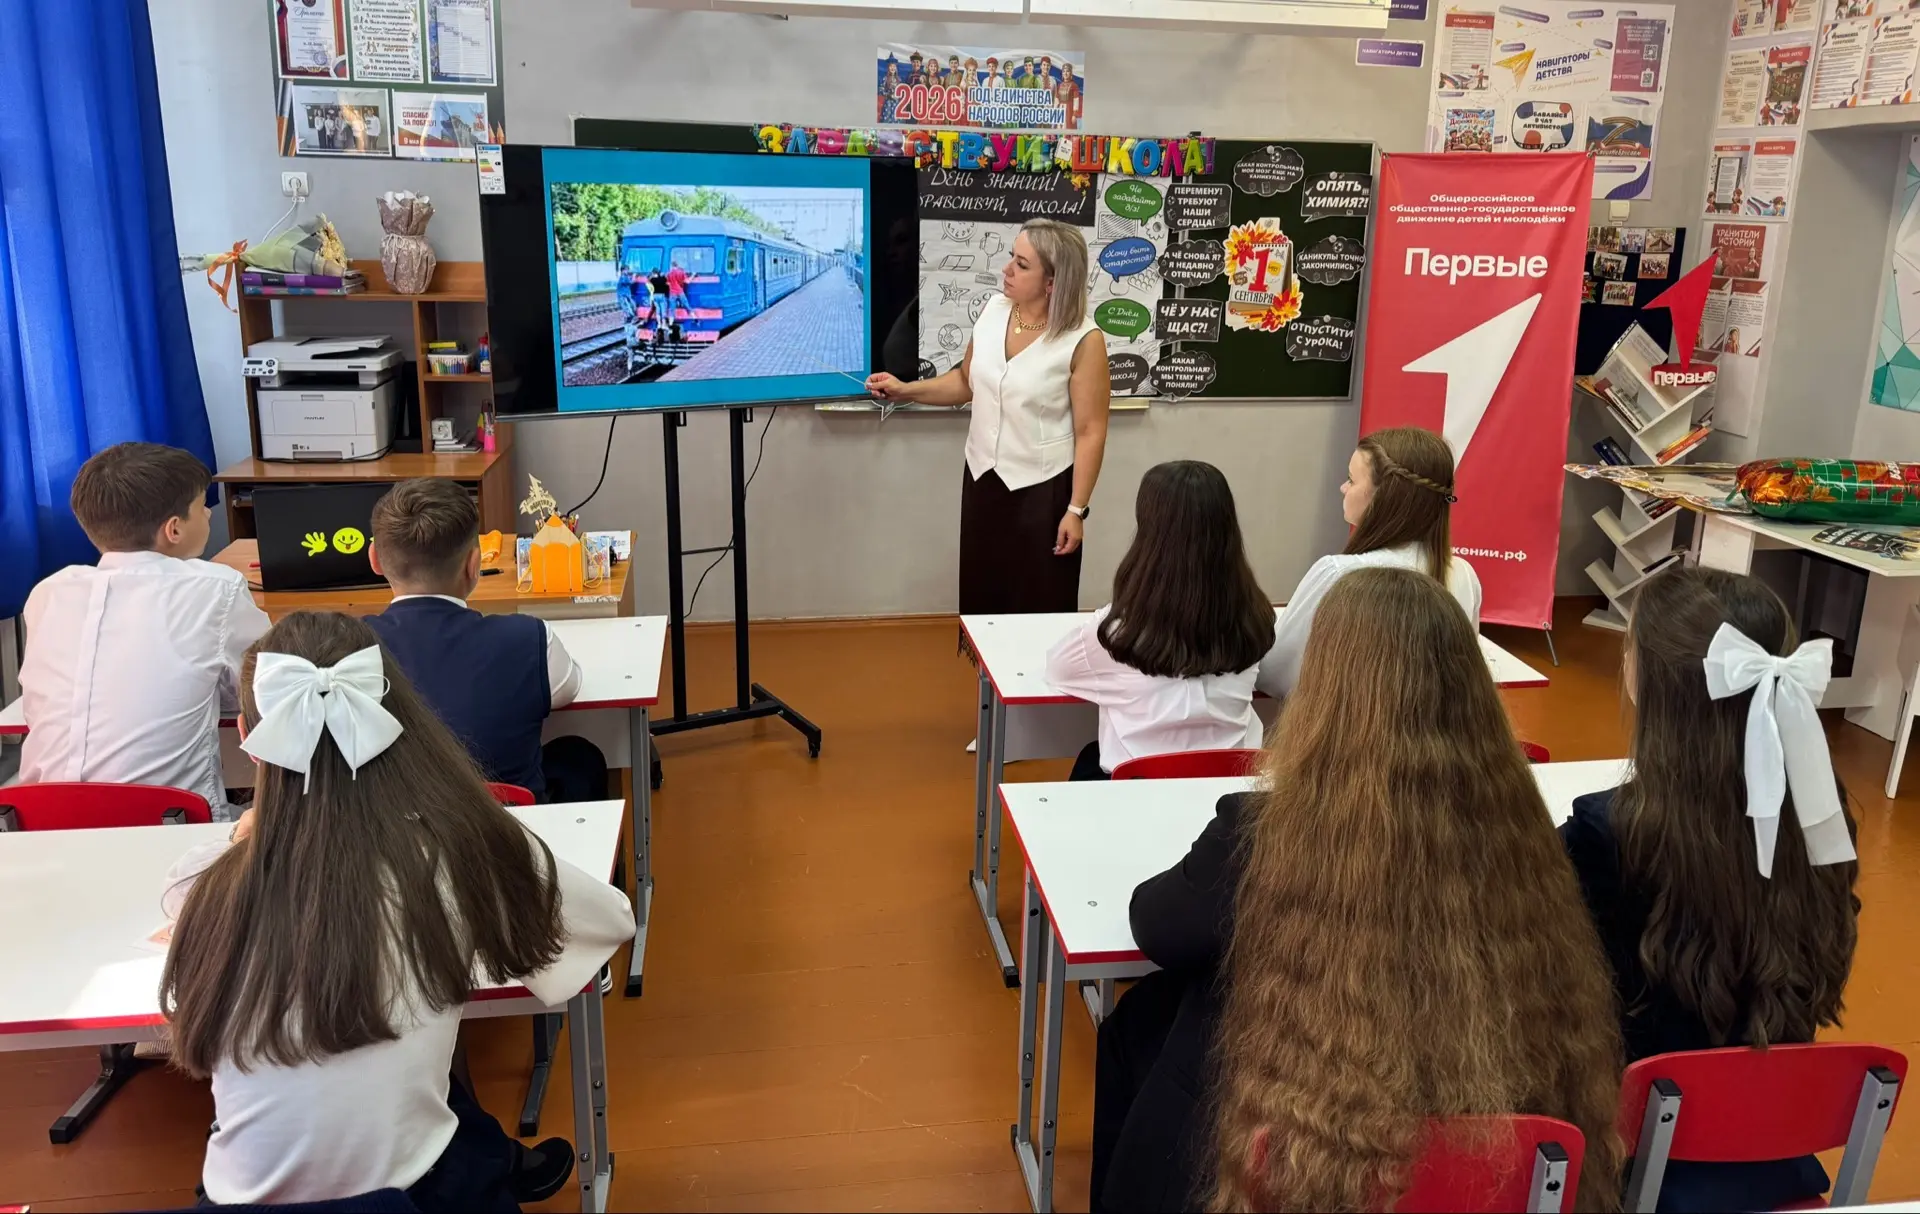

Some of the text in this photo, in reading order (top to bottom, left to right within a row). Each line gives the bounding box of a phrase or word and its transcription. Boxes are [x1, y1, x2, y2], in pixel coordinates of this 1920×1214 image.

[1536, 51, 1590, 69] НАВИГАТОРЫ
[1536, 66, 1573, 81] ДЕТСТВА
[895, 84, 963, 120] 2026
[968, 87, 1052, 106] ГОД ЕДИНСТВА
[968, 106, 1066, 124] НАРОДОВ РОССИИ
[412, 119, 437, 127] ПОБЕУ!
[1072, 136, 1216, 177] ШКОЛА!
[1129, 184, 1142, 193] Не
[1174, 186, 1223, 195] ПЕРЕМЕНУ!
[1316, 180, 1362, 192] ОПЯТЬ
[1112, 193, 1157, 206] задавайте
[1177, 198, 1218, 206] ТРЕБУЮТ
[1306, 196, 1370, 208] ХИМИЯ?!
[1430, 194, 1536, 205] Общероссийское
[1182, 208, 1211, 216] НАШИ
[1389, 204, 1576, 216] общественно-государственное
[1176, 218, 1216, 228] СЕРДЦА!
[1396, 214, 1566, 224] движение детей и молодёжи
[1716, 228, 1760, 239] ХРАНИТЕЛИ
[1718, 237, 1756, 247] ИСТОРИИ
[1105, 246, 1150, 259] Хочу быть
[1164, 250, 1221, 261] А ЧЁ СНОВА Я?
[1298, 253, 1365, 263] КАНИКУЛЫ ТОЧНО
[1104, 254, 1153, 269] старостой!
[1176, 262, 1214, 270] НЕДАВНО
[1301, 262, 1354, 271] ЗАКОНЧИЛИСЬ
[1404, 247, 1549, 286] Первые
[1171, 270, 1211, 279] ОТВЕЧАЛ!
[1248, 248, 1271, 292] 1
[1234, 289, 1274, 304] СЕНТЯБРЯ
[1107, 306, 1139, 317] С Днём
[1160, 304, 1220, 318] ЧЁ У НАС
[1107, 318, 1137, 327] знаний!
[1167, 321, 1208, 334] ЩАС?!
[1290, 322, 1355, 338] ОТПУСТИТИ
[1296, 335, 1343, 350] С УРОКА!
[1108, 359, 1136, 369] Снова
[1171, 357, 1195, 365] КАКАЯ
[1156, 365, 1211, 373] КОНТРОЛЬНАЯ?
[1654, 370, 1716, 387] Первые
[1165, 381, 1198, 389] ПОНЯЛИ!
